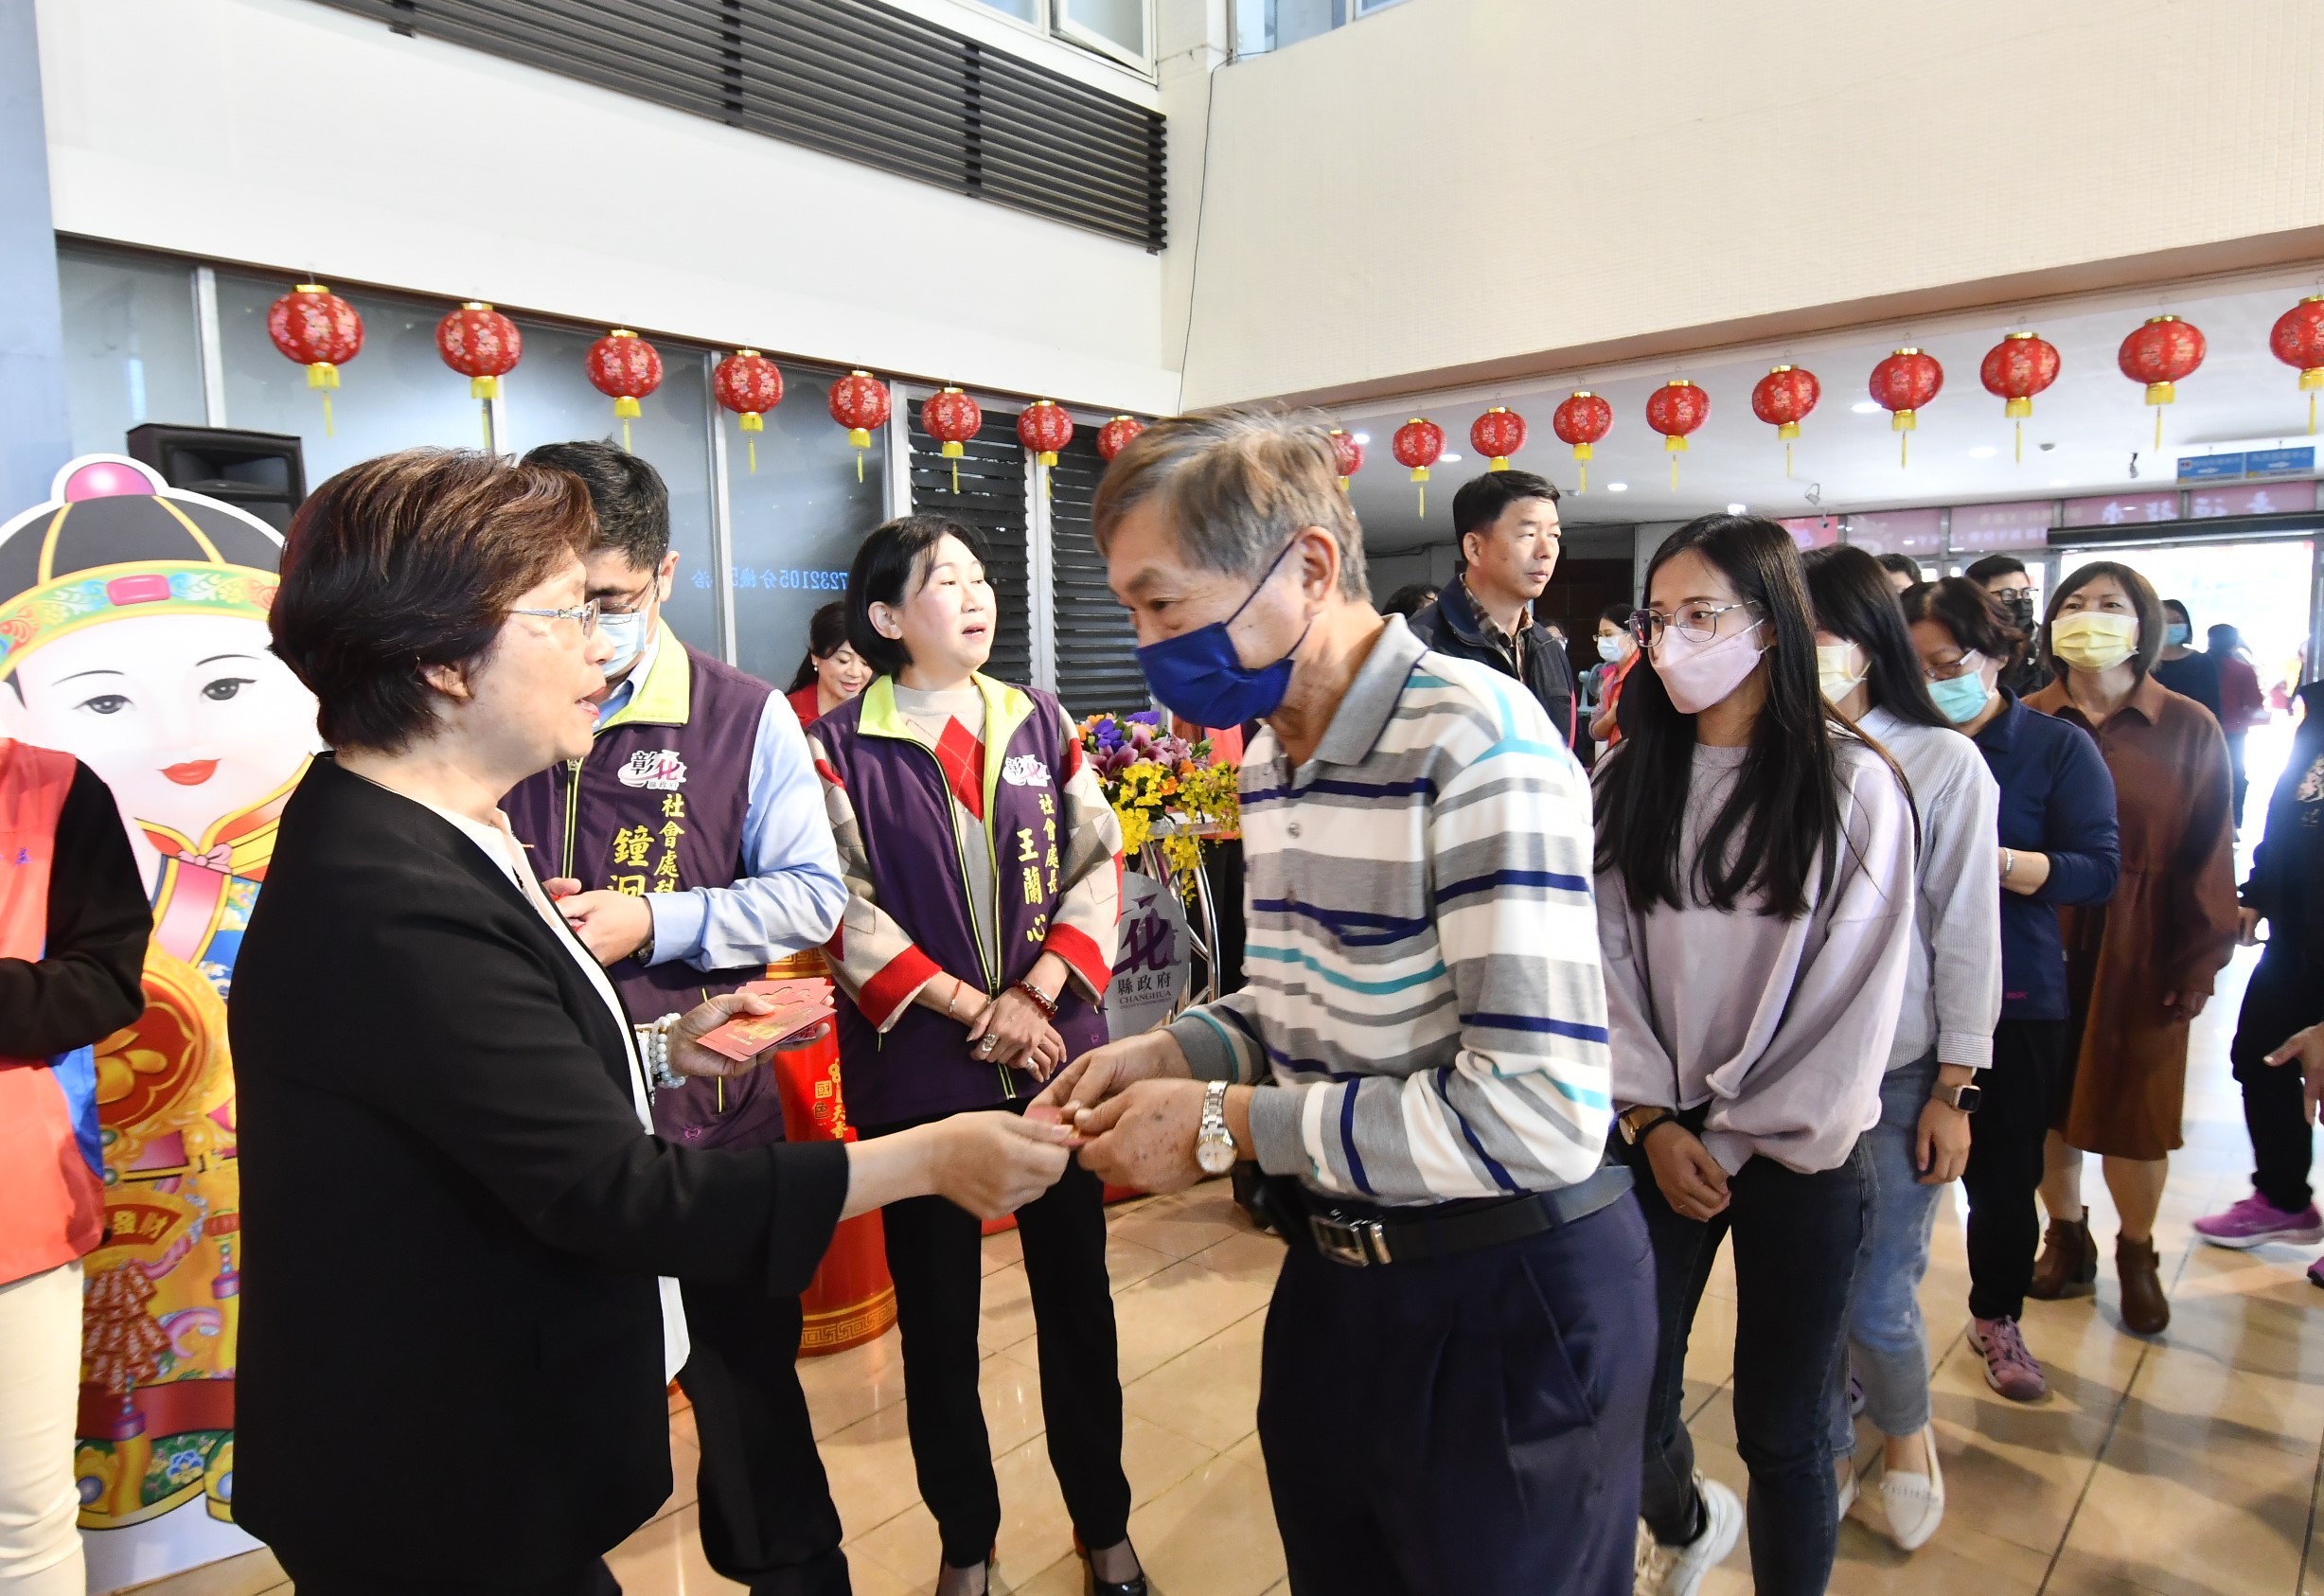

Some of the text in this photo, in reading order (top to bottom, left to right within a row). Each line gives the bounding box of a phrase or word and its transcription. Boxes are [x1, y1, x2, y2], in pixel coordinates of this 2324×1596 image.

[630, 752, 681, 780] 彰化
[1038, 793, 1059, 895] 社會處長
[1016, 828, 1047, 943] 王蘭心
[1118, 972, 1171, 995] 縣政府
[1120, 989, 1172, 1005] CHANGHUA
